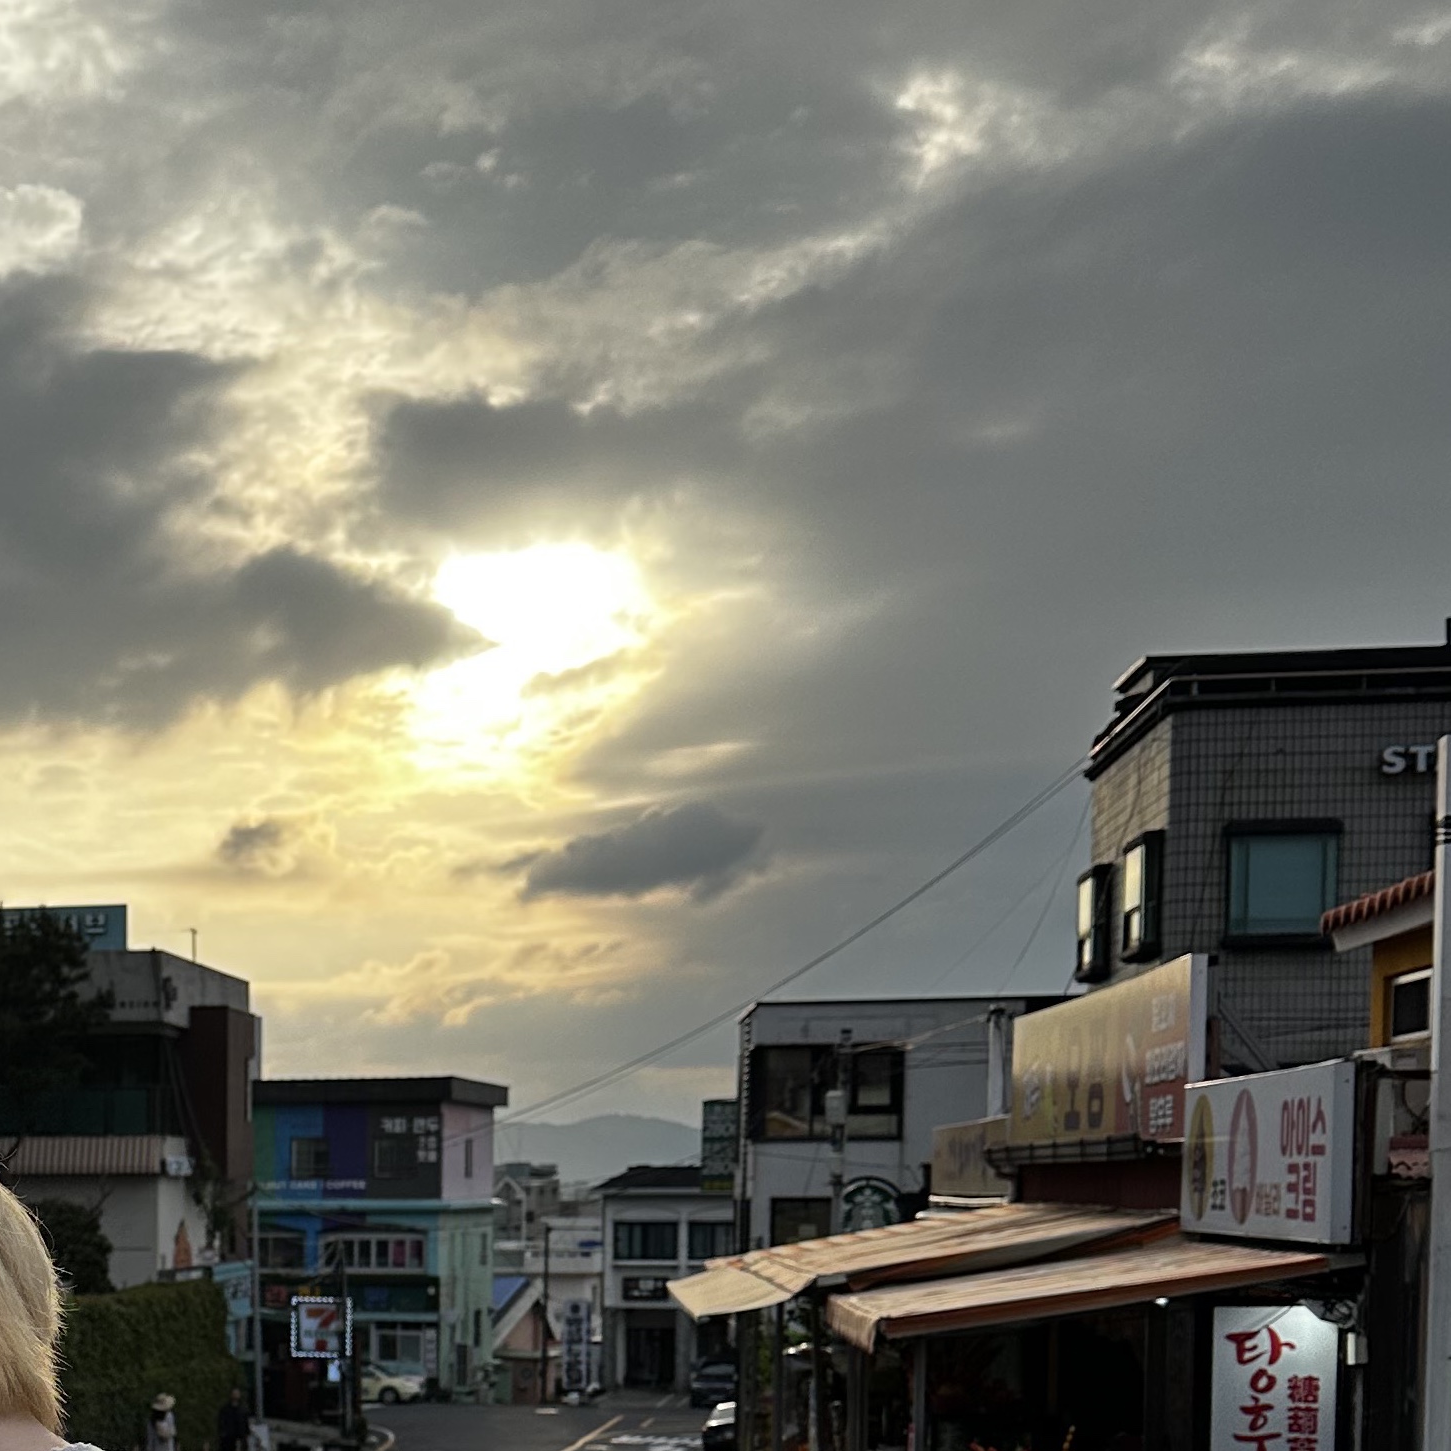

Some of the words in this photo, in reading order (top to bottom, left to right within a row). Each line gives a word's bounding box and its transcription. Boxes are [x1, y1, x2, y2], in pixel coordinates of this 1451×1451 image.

[1280, 1095, 1327, 1157] 아이스
[326, 1178, 367, 1191] COFFEE
[1211, 1177, 1227, 1211] 초코
[1255, 1182, 1283, 1217] 바닐라
[1285, 1161, 1318, 1223] 크림
